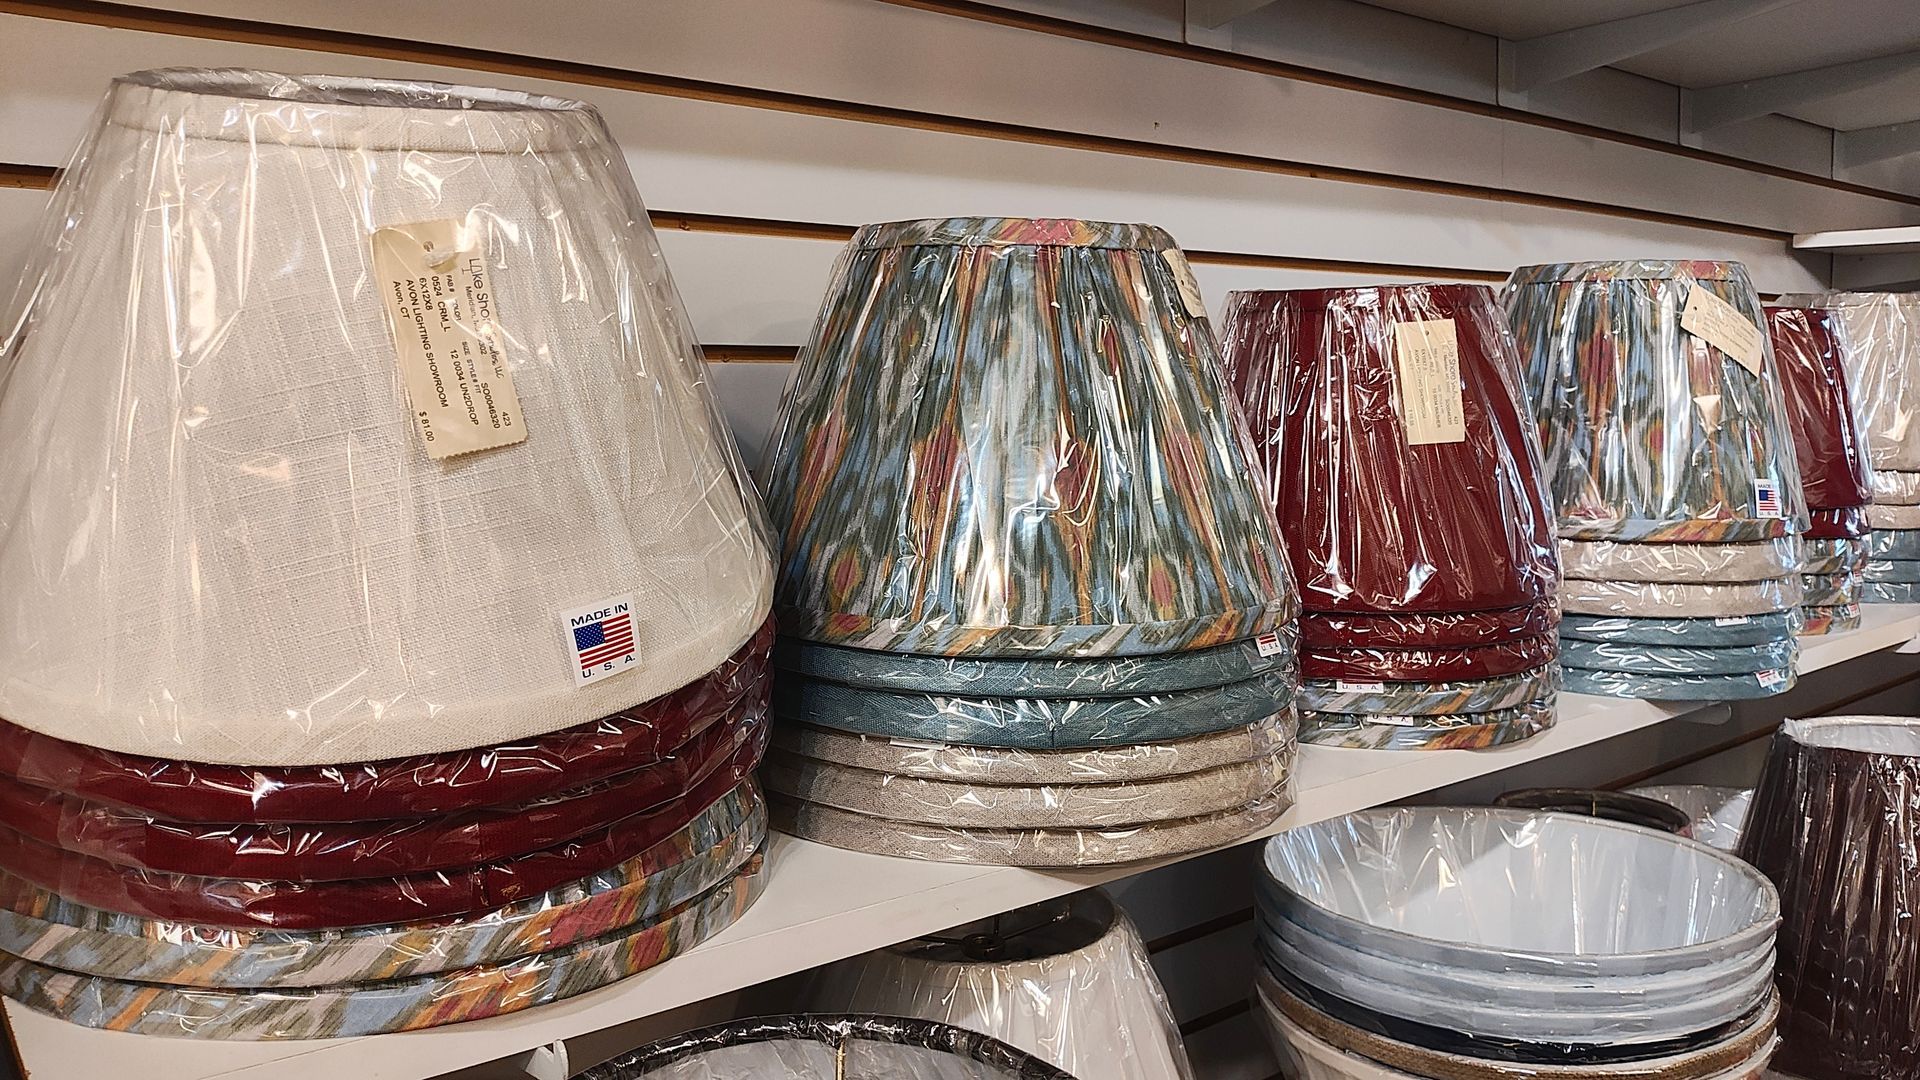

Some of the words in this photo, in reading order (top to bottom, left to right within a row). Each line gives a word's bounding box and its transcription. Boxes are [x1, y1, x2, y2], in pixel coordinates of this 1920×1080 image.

[418, 277, 433, 311] 6X12X8
[431, 275, 443, 296] 0524
[393, 281, 404, 305] Avon,
[400, 306, 410, 319] CT
[477, 293, 493, 325] Sho
[437, 301, 451, 332] CRM_L
[406, 279, 419, 306] AVON
[413, 307, 431, 350] LIGHTING
[426, 352, 449, 407] SHOWROOM
[450, 349, 459, 359] 12
[453, 361, 465, 380] 0034
[467, 359, 477, 378] STYLE
[460, 382, 479, 425] UN2DROP
[421, 419, 435, 442] 81.00
[502, 411, 511, 426] 423
[571, 608, 611, 627] MADE
[614, 603, 628, 614] IN
